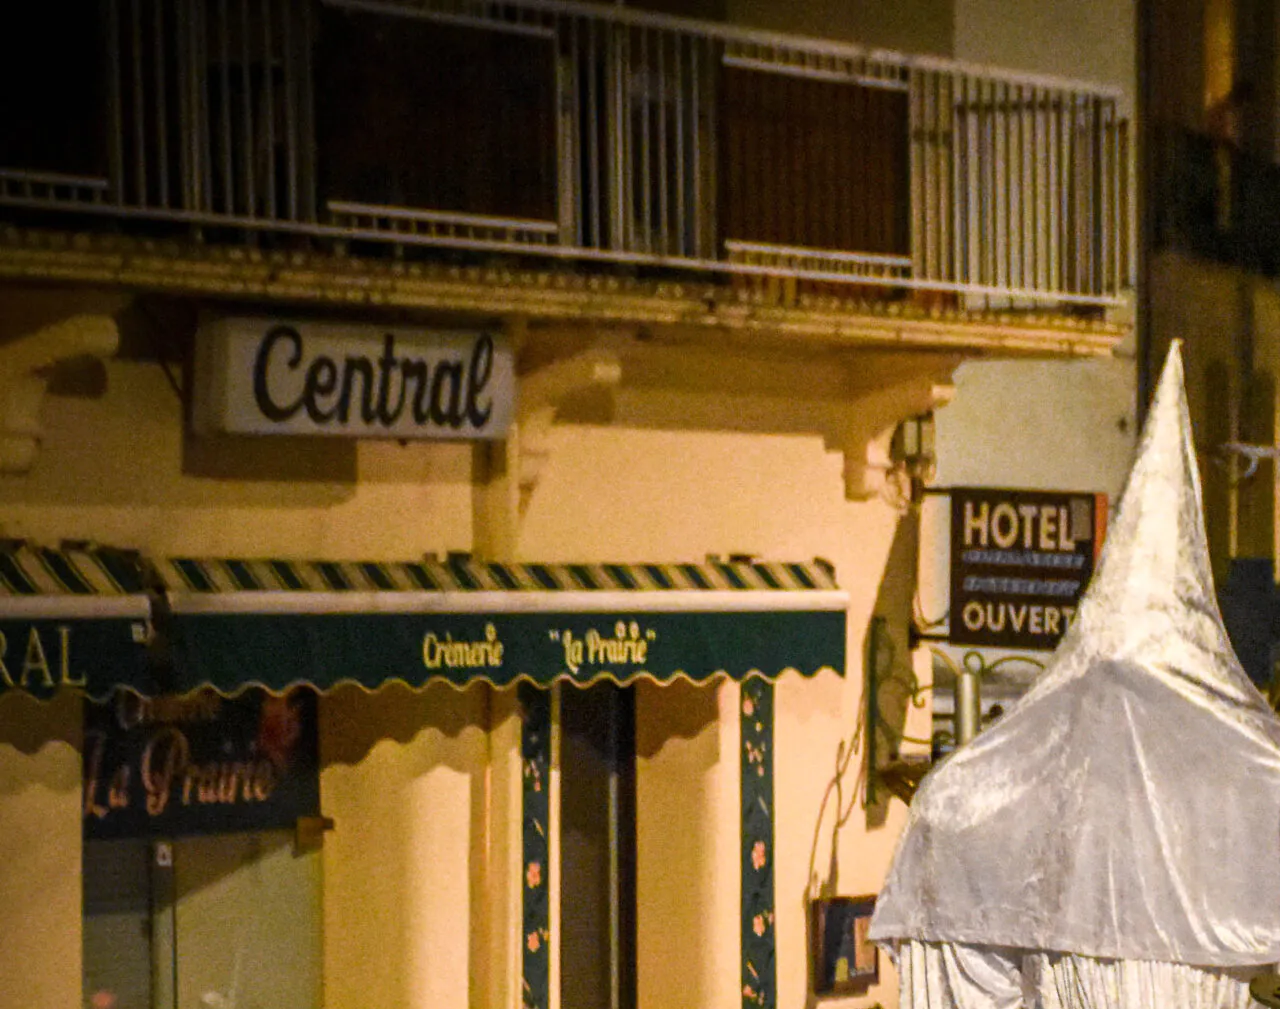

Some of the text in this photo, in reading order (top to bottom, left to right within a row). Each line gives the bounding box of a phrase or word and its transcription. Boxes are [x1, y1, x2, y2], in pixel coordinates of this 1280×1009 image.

[253, 324, 495, 429] Central
[963, 501, 1076, 551] HOTEL
[962, 601, 1076, 635] OUVERT
